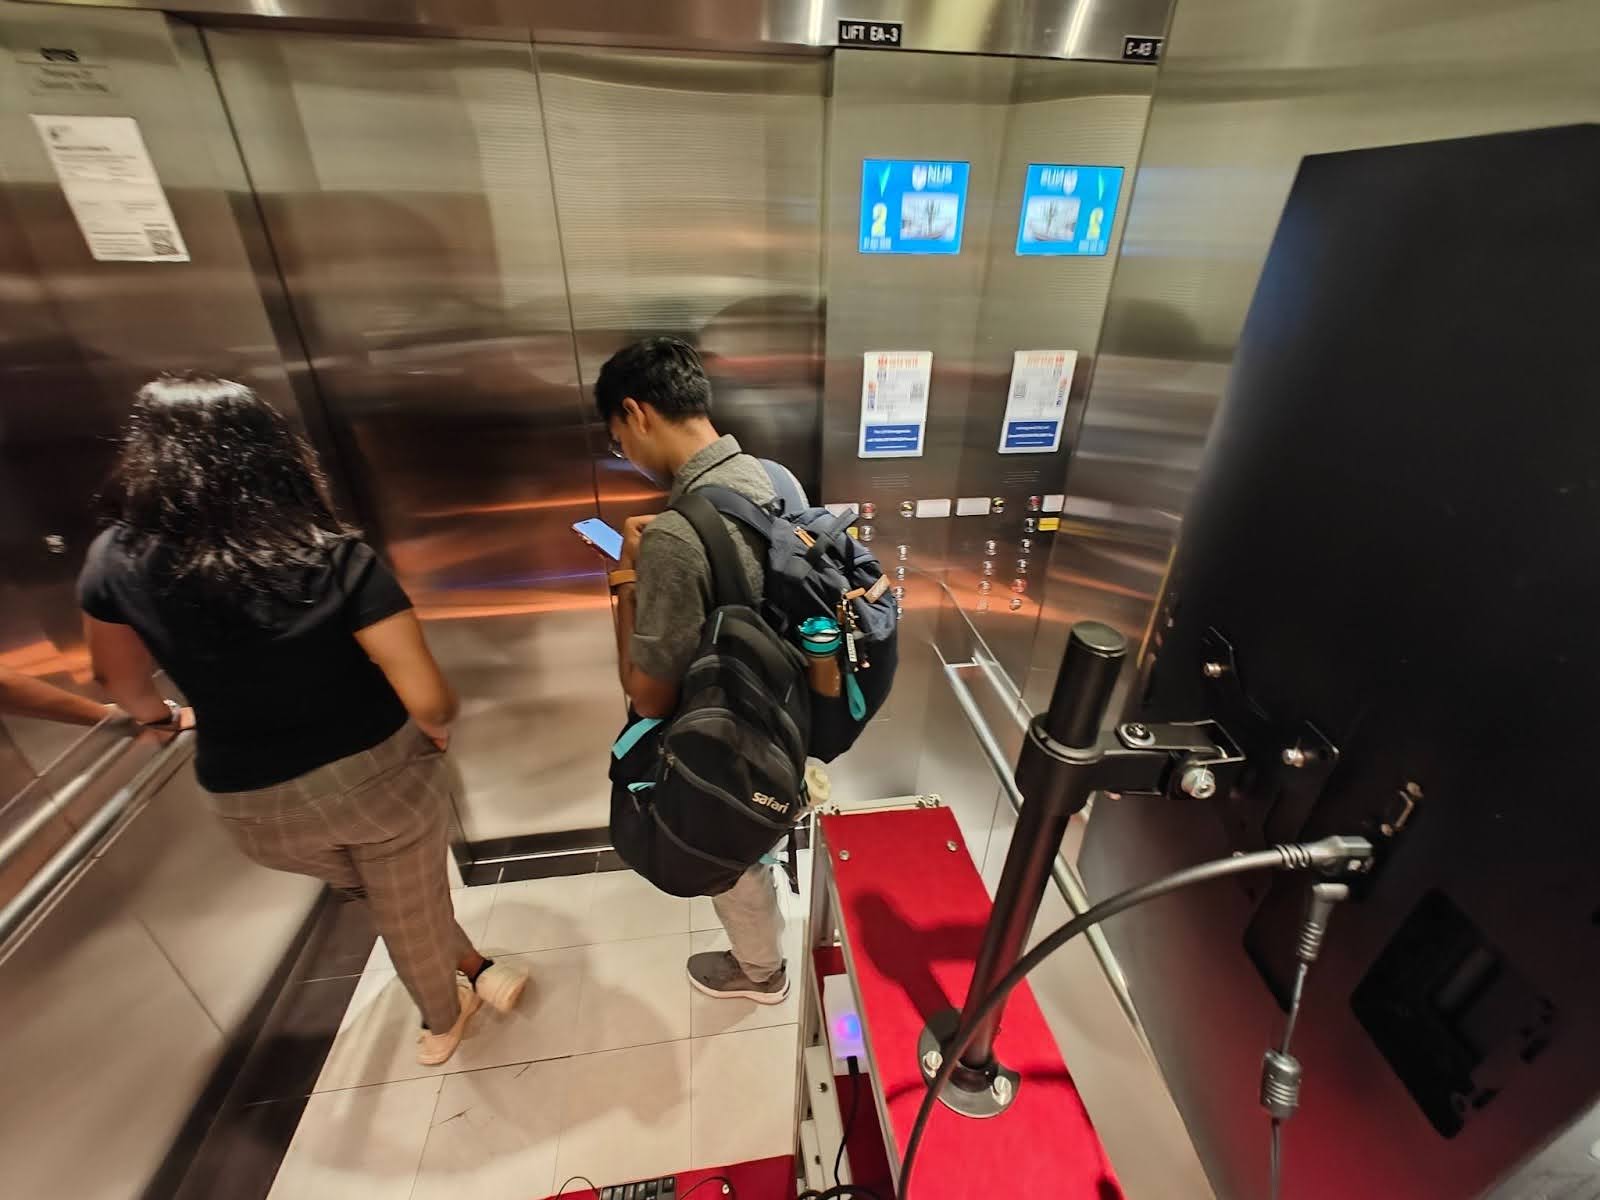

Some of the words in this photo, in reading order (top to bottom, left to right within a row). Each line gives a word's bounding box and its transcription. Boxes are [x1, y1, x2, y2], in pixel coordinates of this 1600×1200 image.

[842, 24, 865, 40] LIFT
[870, 25, 899, 42] EA-3
[871, 203, 887, 238] 2
[752, 792, 790, 814] safari
